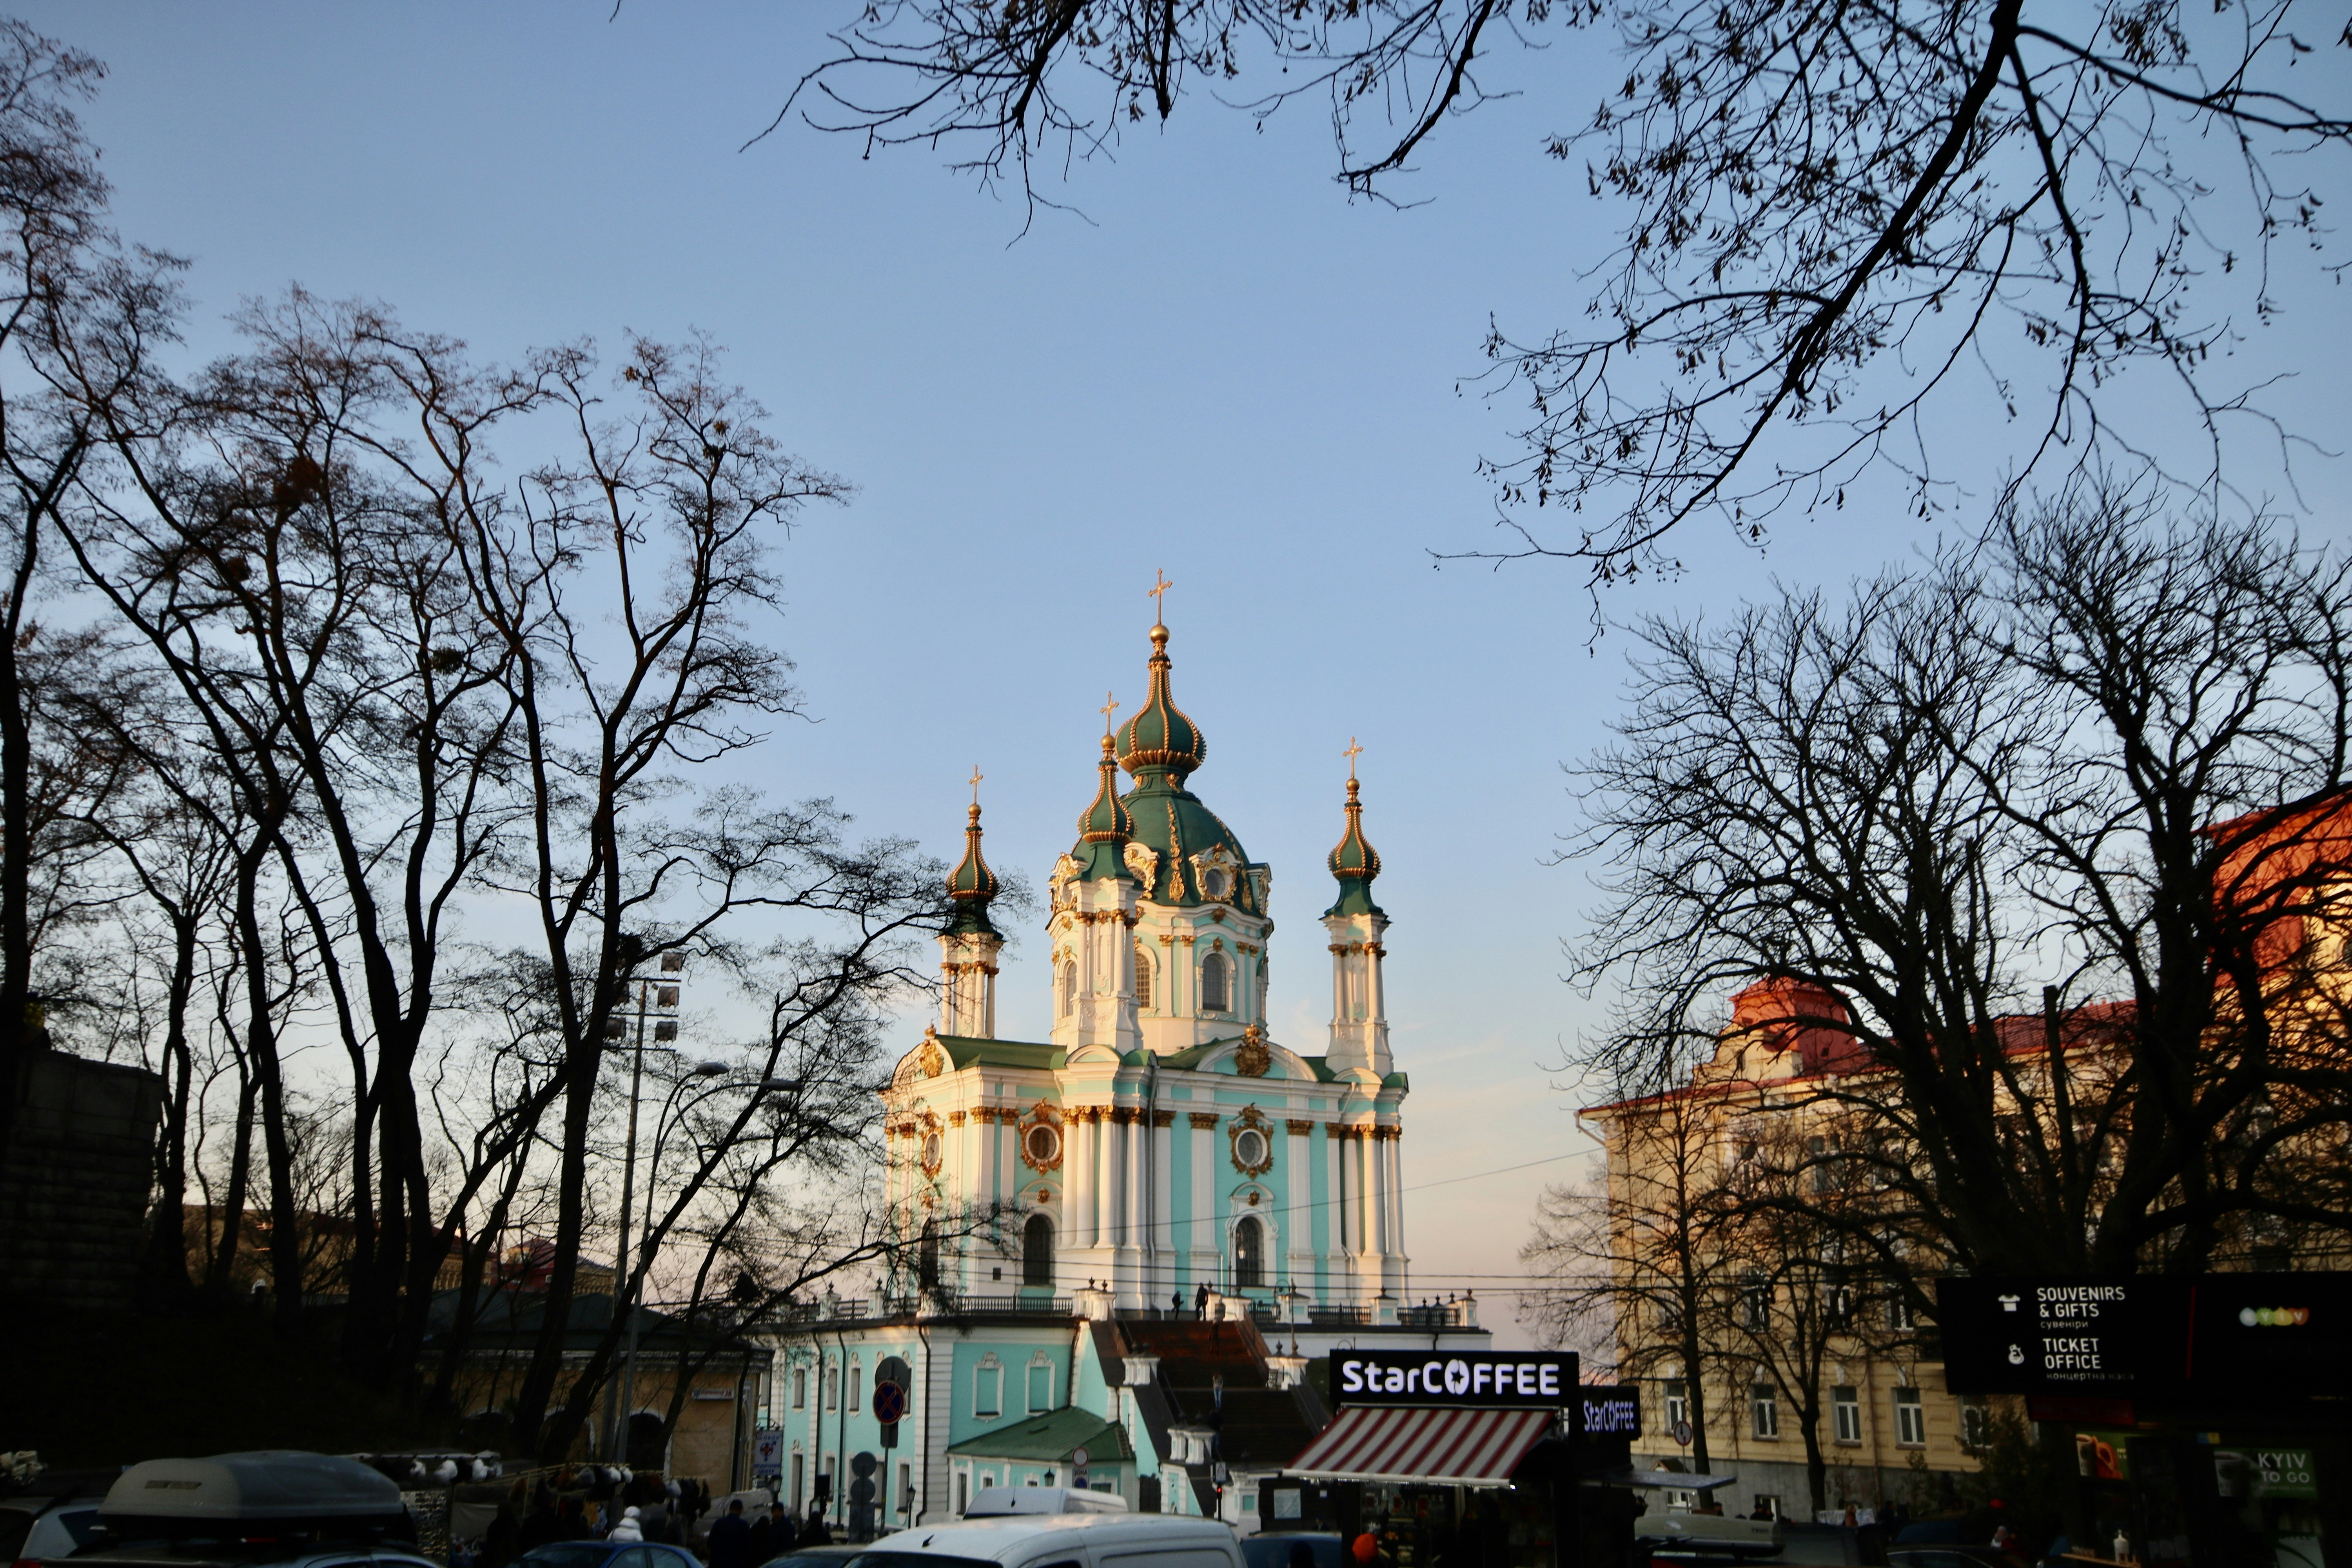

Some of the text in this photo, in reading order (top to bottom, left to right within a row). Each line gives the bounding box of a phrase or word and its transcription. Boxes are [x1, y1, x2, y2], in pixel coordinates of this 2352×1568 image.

[2037, 1286, 2126, 1301] SOUVENIRS
[2039, 1303, 2100, 1318] & GIFTS
[2040, 1319, 2089, 1330] сувеніри
[2042, 1338, 2100, 1353] TICKET
[2045, 1354, 2102, 1369] OFFICE
[1342, 1359, 1560, 1396] StarCOFFEE
[2046, 1372, 2105, 1382] концертна
[1583, 1399, 1635, 1432] StarCOFFEE
[2258, 1452, 2306, 1468] KYIV
[2261, 1471, 2310, 1483] TO GO
